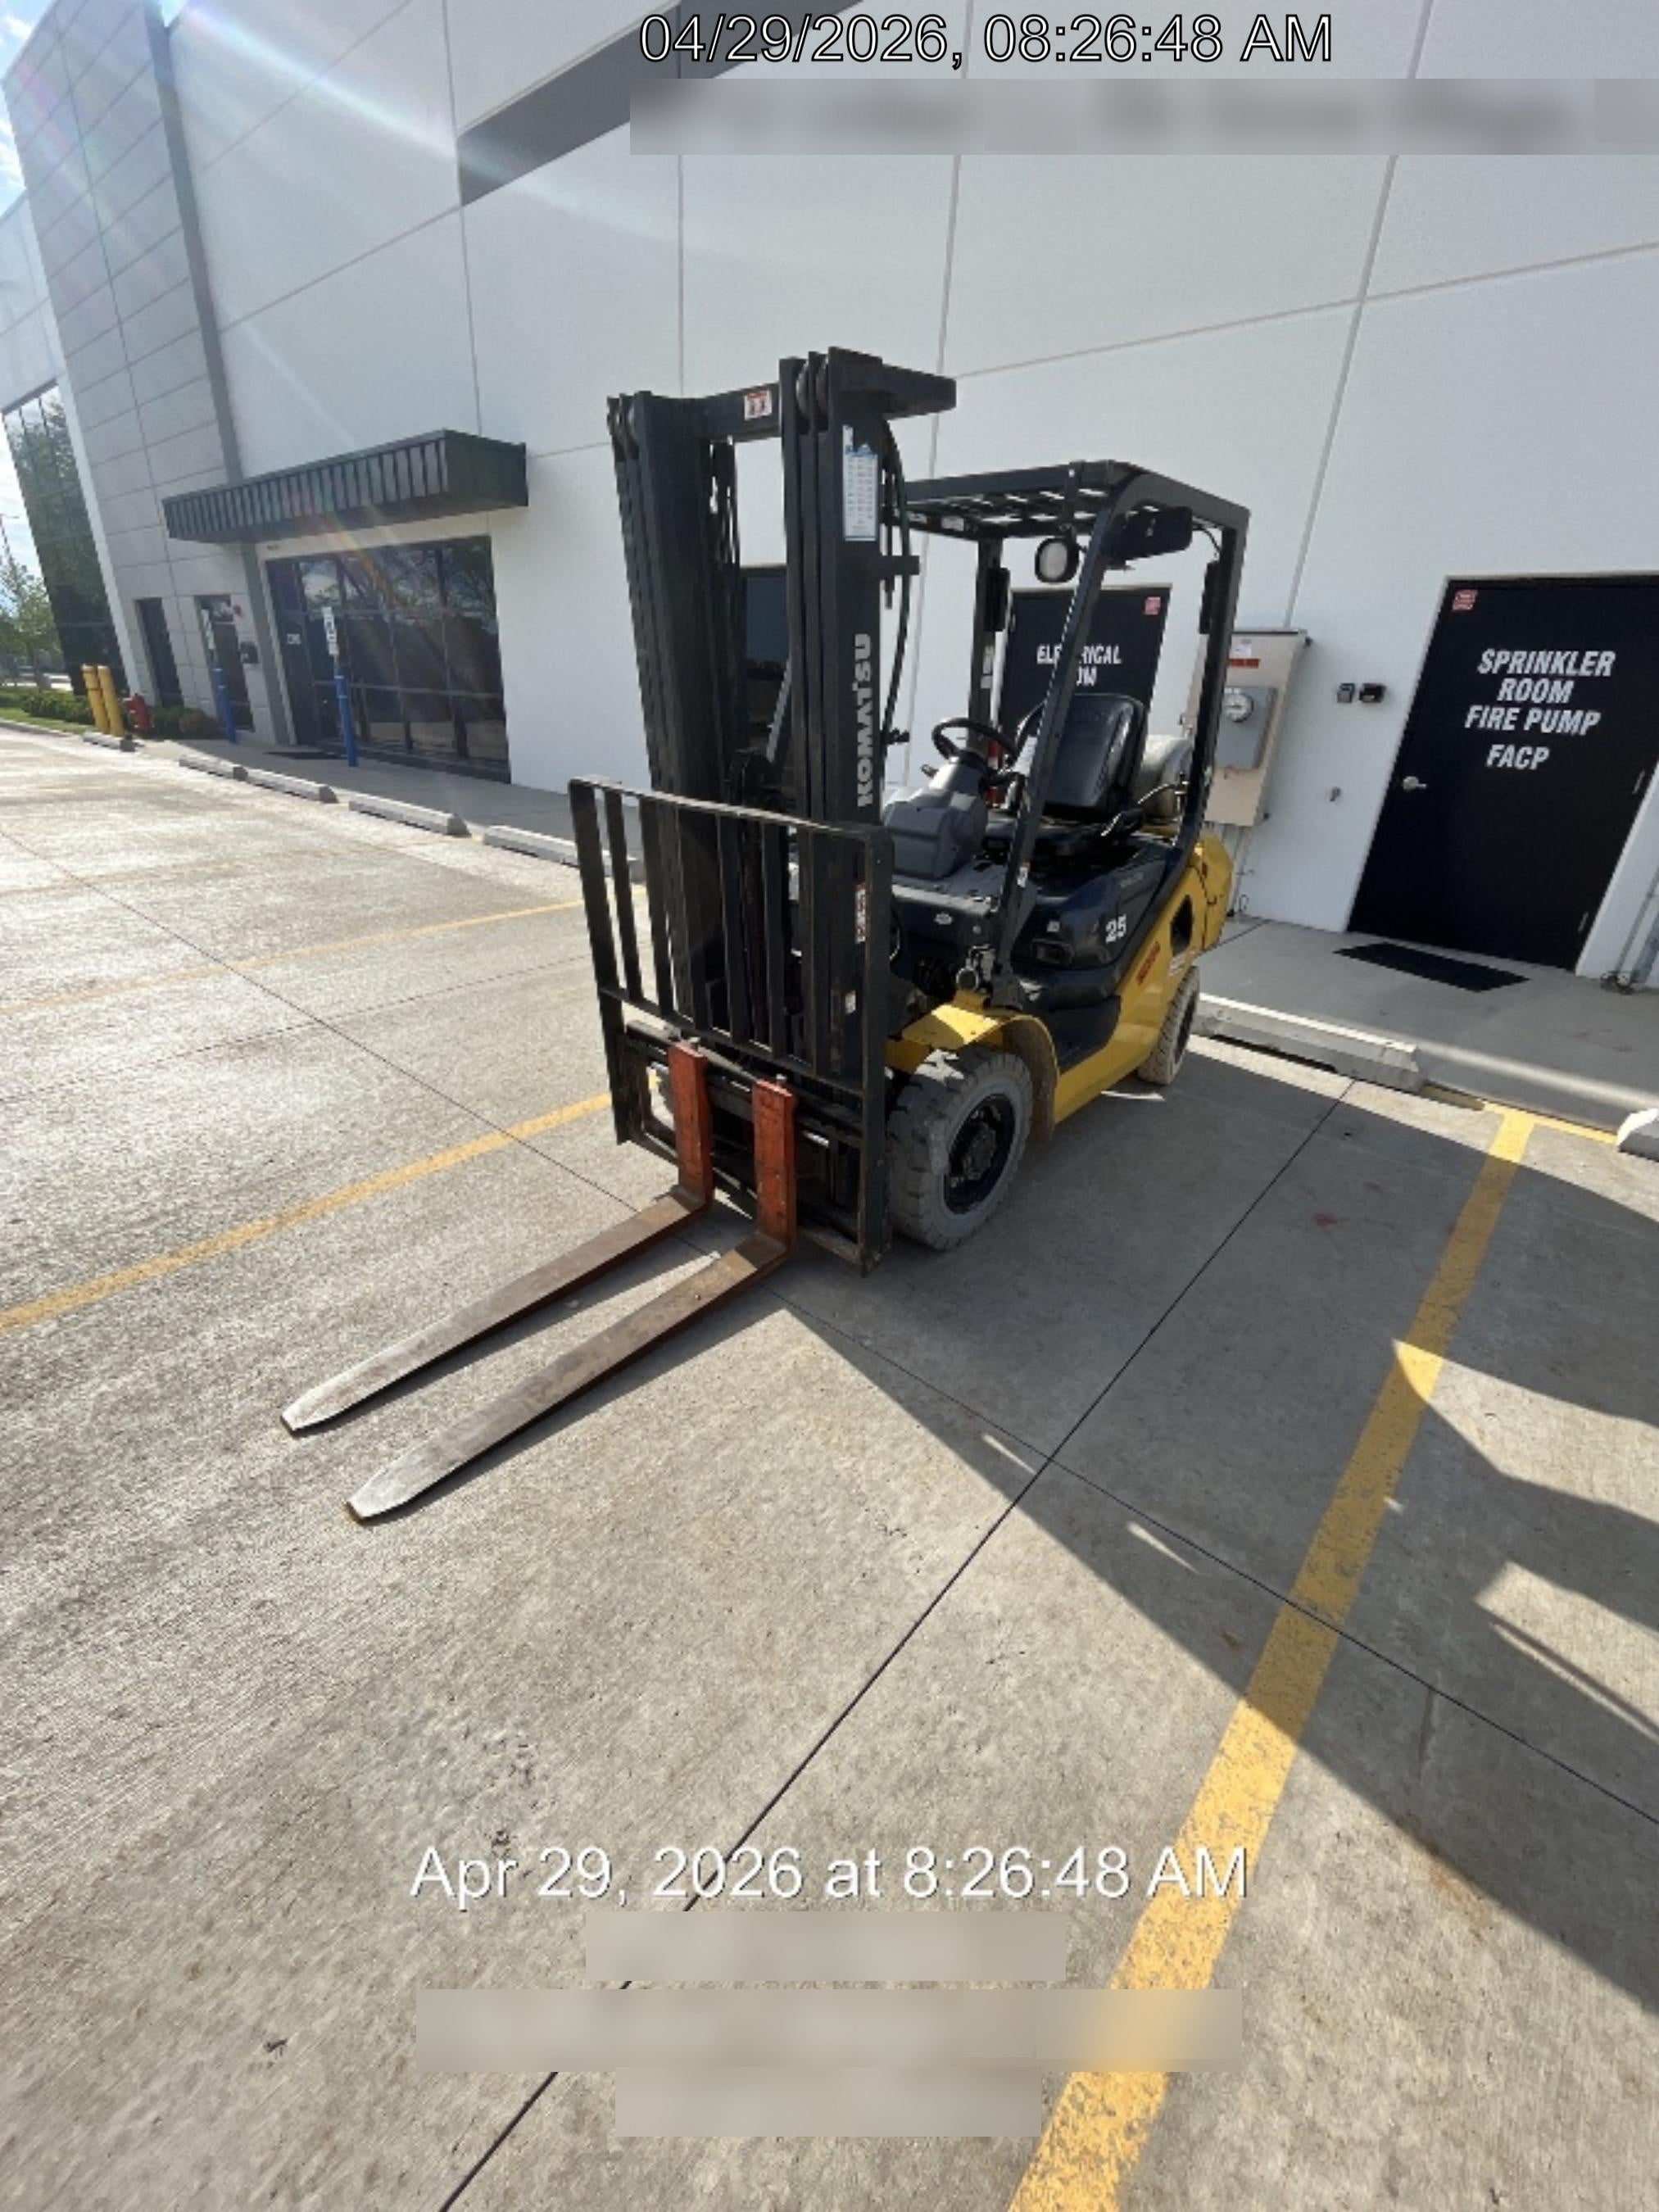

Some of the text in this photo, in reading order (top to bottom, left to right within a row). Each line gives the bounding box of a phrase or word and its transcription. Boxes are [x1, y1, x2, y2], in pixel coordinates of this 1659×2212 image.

[1477, 648, 1616, 677] SPRINKLER
[1497, 678, 1575, 704] ROOM
[852, 633, 873, 808] KOMATSU
[1464, 705, 1602, 736] FIRE PUMP
[1486, 744, 1550, 770] FACP
[1105, 913, 1126, 944] 25
